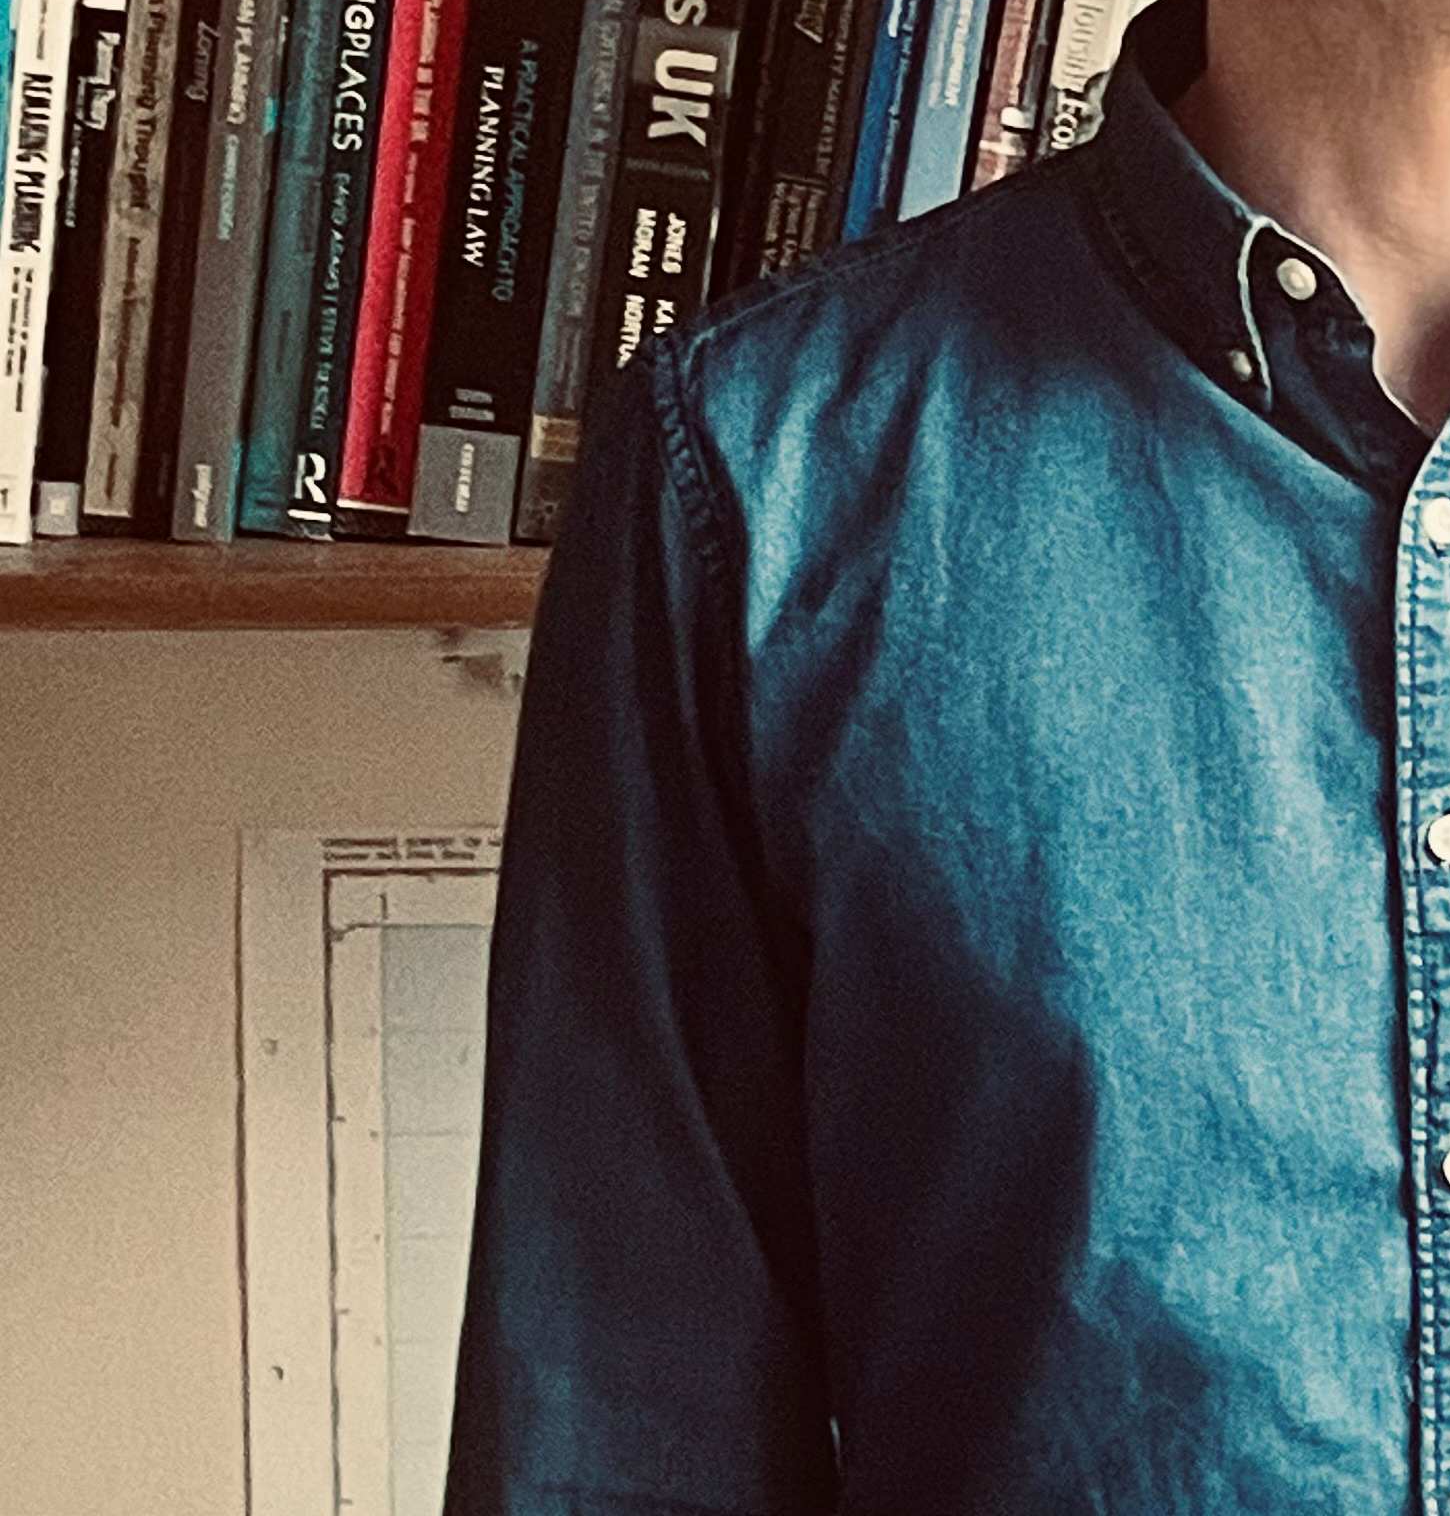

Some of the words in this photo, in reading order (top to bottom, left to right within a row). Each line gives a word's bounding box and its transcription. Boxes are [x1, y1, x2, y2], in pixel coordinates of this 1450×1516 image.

[135, 10, 167, 111] Planning
[521, 38, 538, 53] A
[470, 66, 505, 201] PLANNING
[507, 59, 538, 163] PRACTICAL
[647, 49, 718, 146] UK
[126, 117, 159, 211] Thought
[463, 209, 489, 267] LAW
[497, 170, 524, 273] APPROACH
[628, 208, 657, 278] MORAN
[661, 212, 686, 274] JONES
